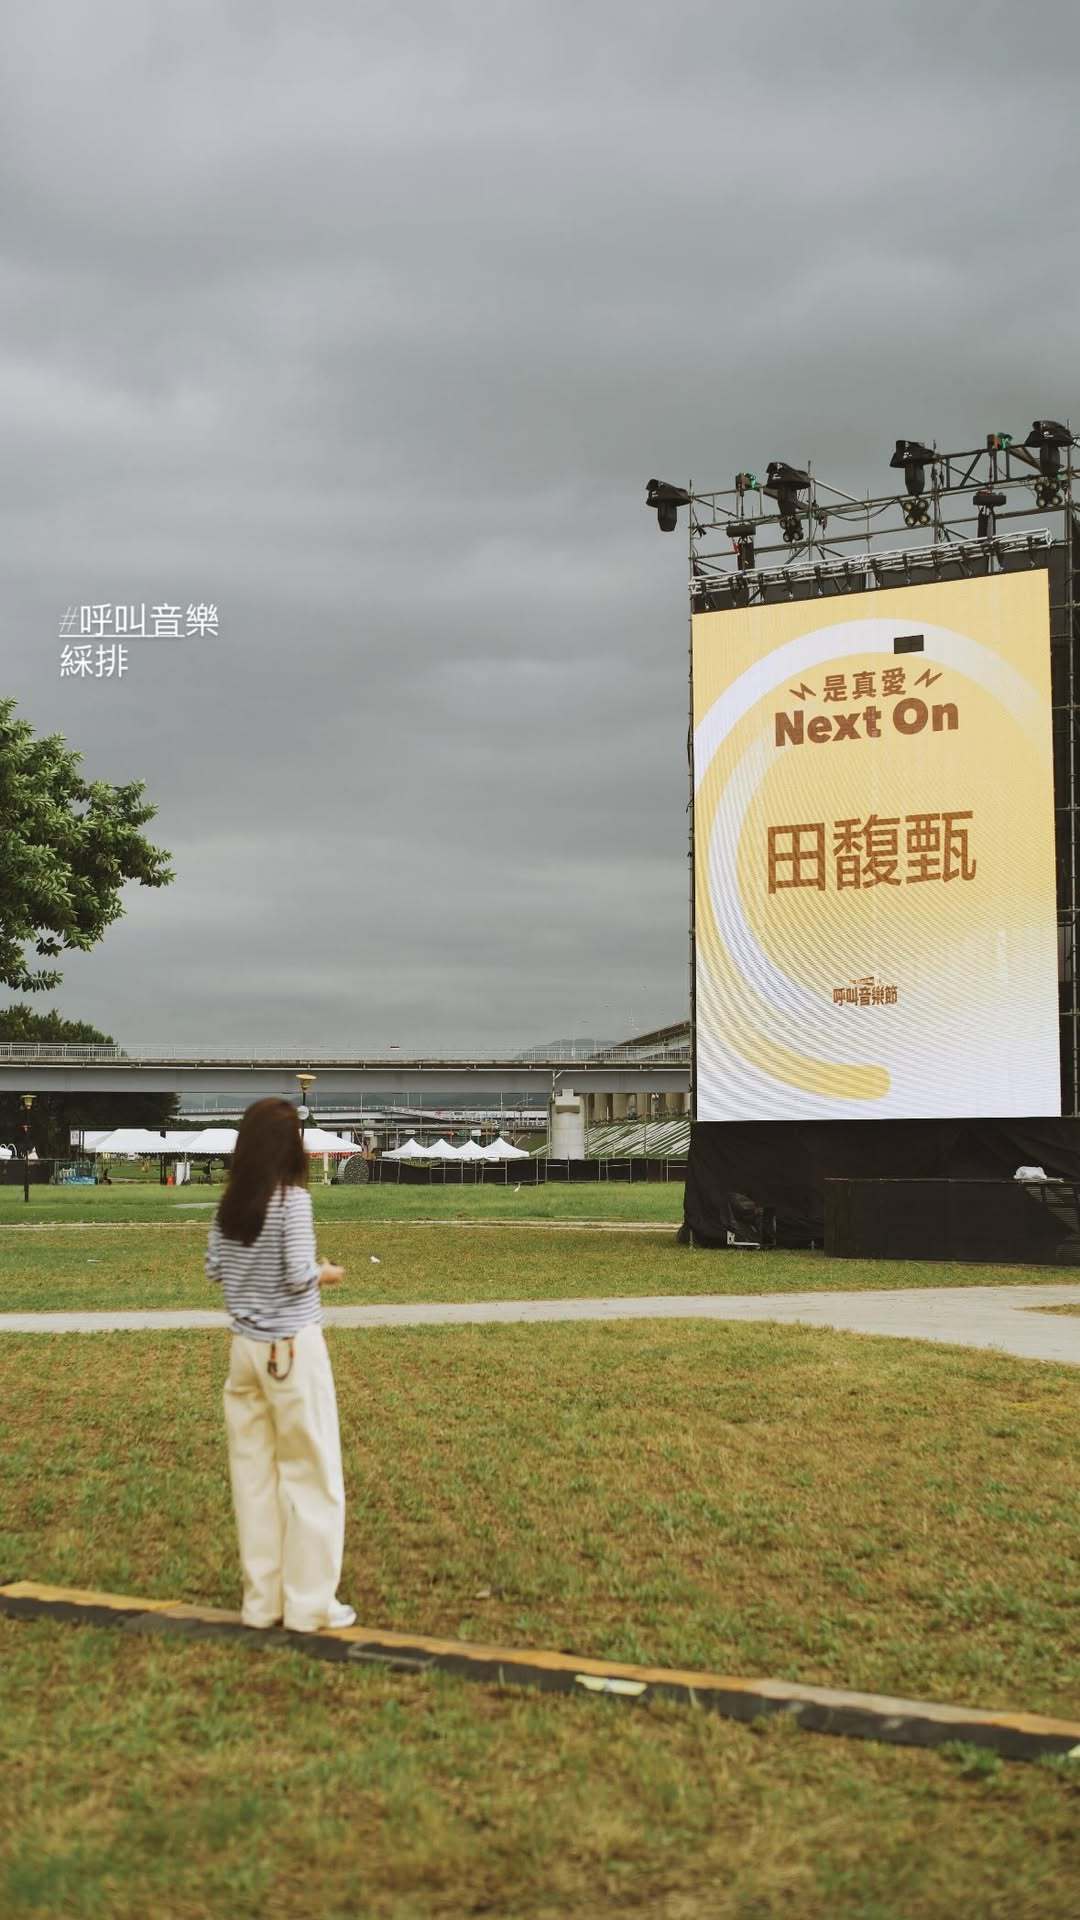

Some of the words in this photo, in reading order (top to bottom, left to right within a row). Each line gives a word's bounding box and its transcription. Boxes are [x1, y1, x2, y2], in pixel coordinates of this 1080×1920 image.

[823, 666, 907, 703] 是真愛
[774, 705, 882, 747] Next
[892, 697, 959, 735] On
[766, 809, 977, 895] 田馥甄
